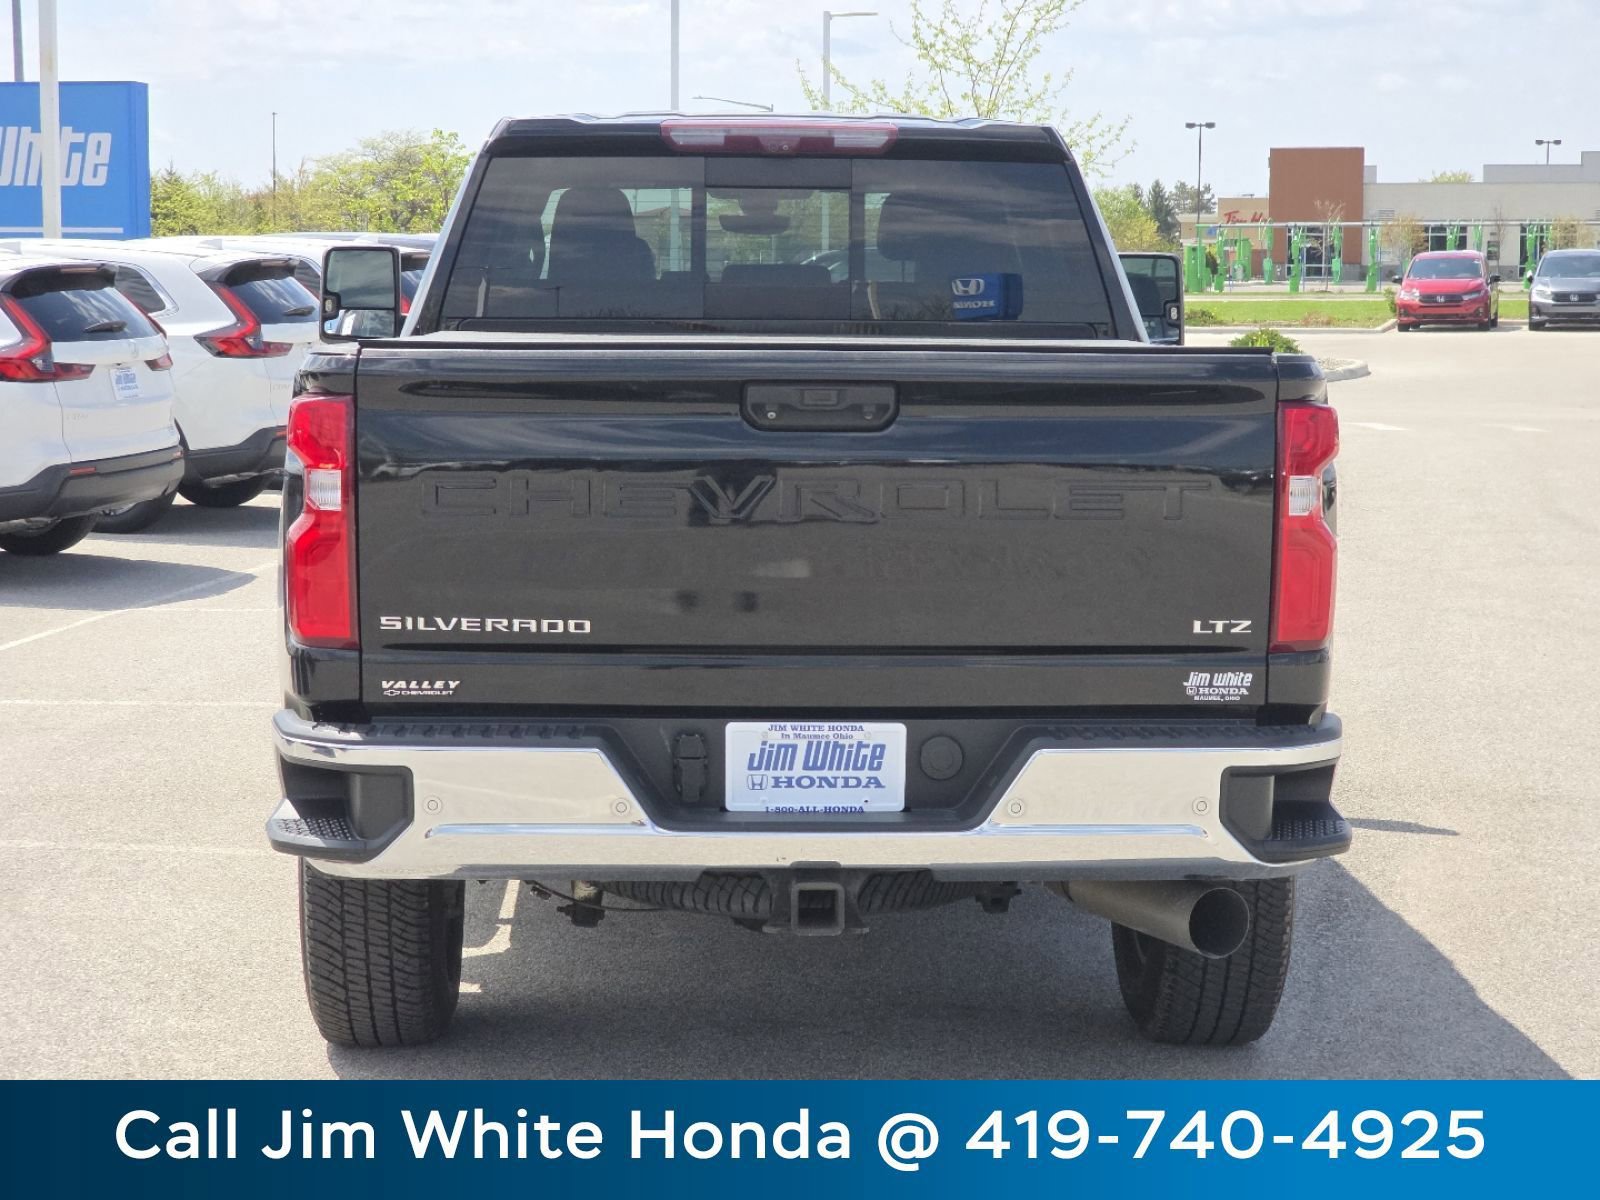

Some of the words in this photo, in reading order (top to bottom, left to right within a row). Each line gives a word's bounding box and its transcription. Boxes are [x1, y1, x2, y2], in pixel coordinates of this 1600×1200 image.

[422, 478, 1212, 523] CHEVROLET
[380, 616, 591, 633] SILVERADO
[1193, 620, 1252, 633] LTZ
[381, 680, 461, 689] VALLEY
[1183, 671, 1211, 686] Jim
[1198, 687, 1249, 695] HONDA
[768, 724, 787, 732] JIM
[790, 724, 825, 732] WHITE
[828, 724, 865, 732] HONDA
[802, 740, 886, 771] White
[771, 775, 886, 789] HONDA
[765, 806, 865, 814] 1-800-ALL-HONDA
